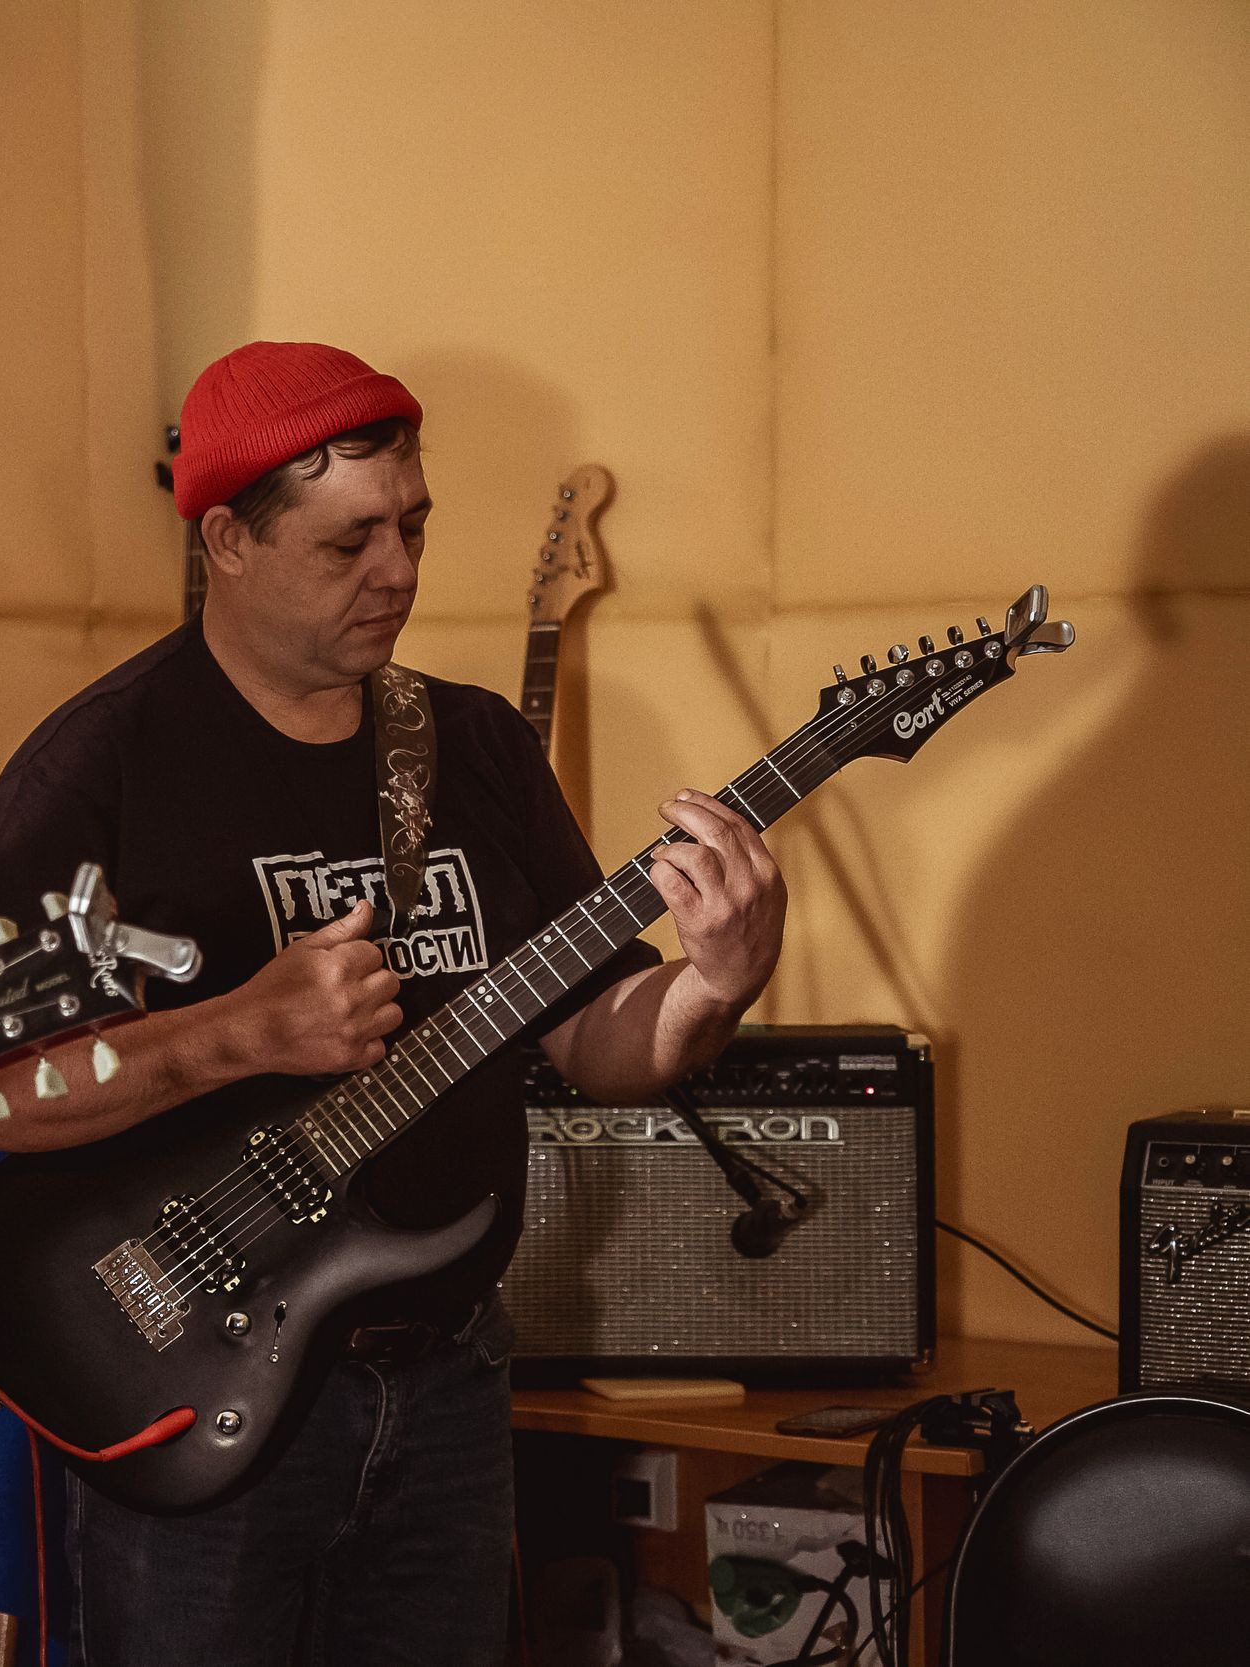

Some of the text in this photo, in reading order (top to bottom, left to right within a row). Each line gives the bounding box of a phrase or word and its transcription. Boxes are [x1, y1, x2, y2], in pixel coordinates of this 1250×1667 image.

[949, 695, 963, 707] VIVA
[963, 679, 984, 697] SERIES
[893, 691, 945, 739] Cort
[527, 1115, 841, 1142] ROCKRON
